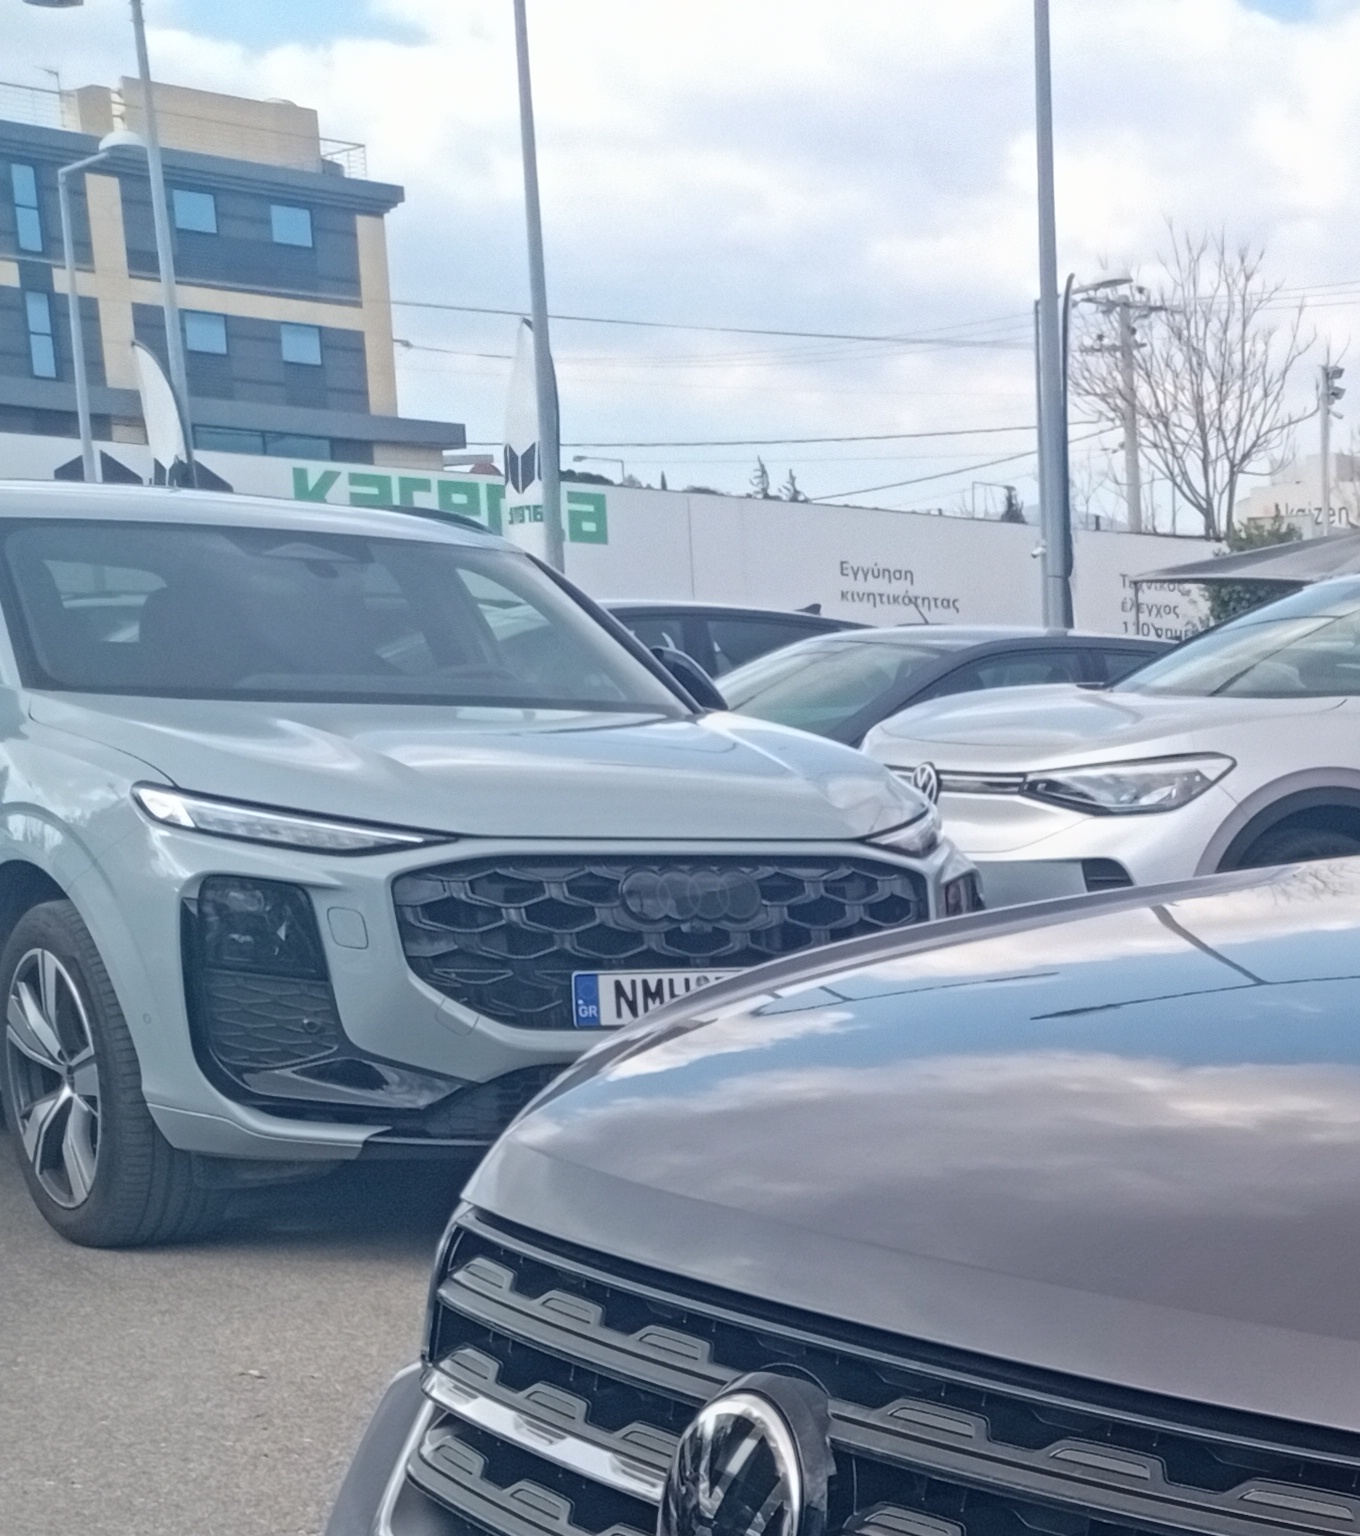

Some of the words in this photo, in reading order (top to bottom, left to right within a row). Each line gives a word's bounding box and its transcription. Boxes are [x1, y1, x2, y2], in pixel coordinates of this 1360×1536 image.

[839, 560, 914, 586] Εγγύηση
[840, 589, 960, 614] κινητικότητας
[578, 1005, 598, 1018] GR
